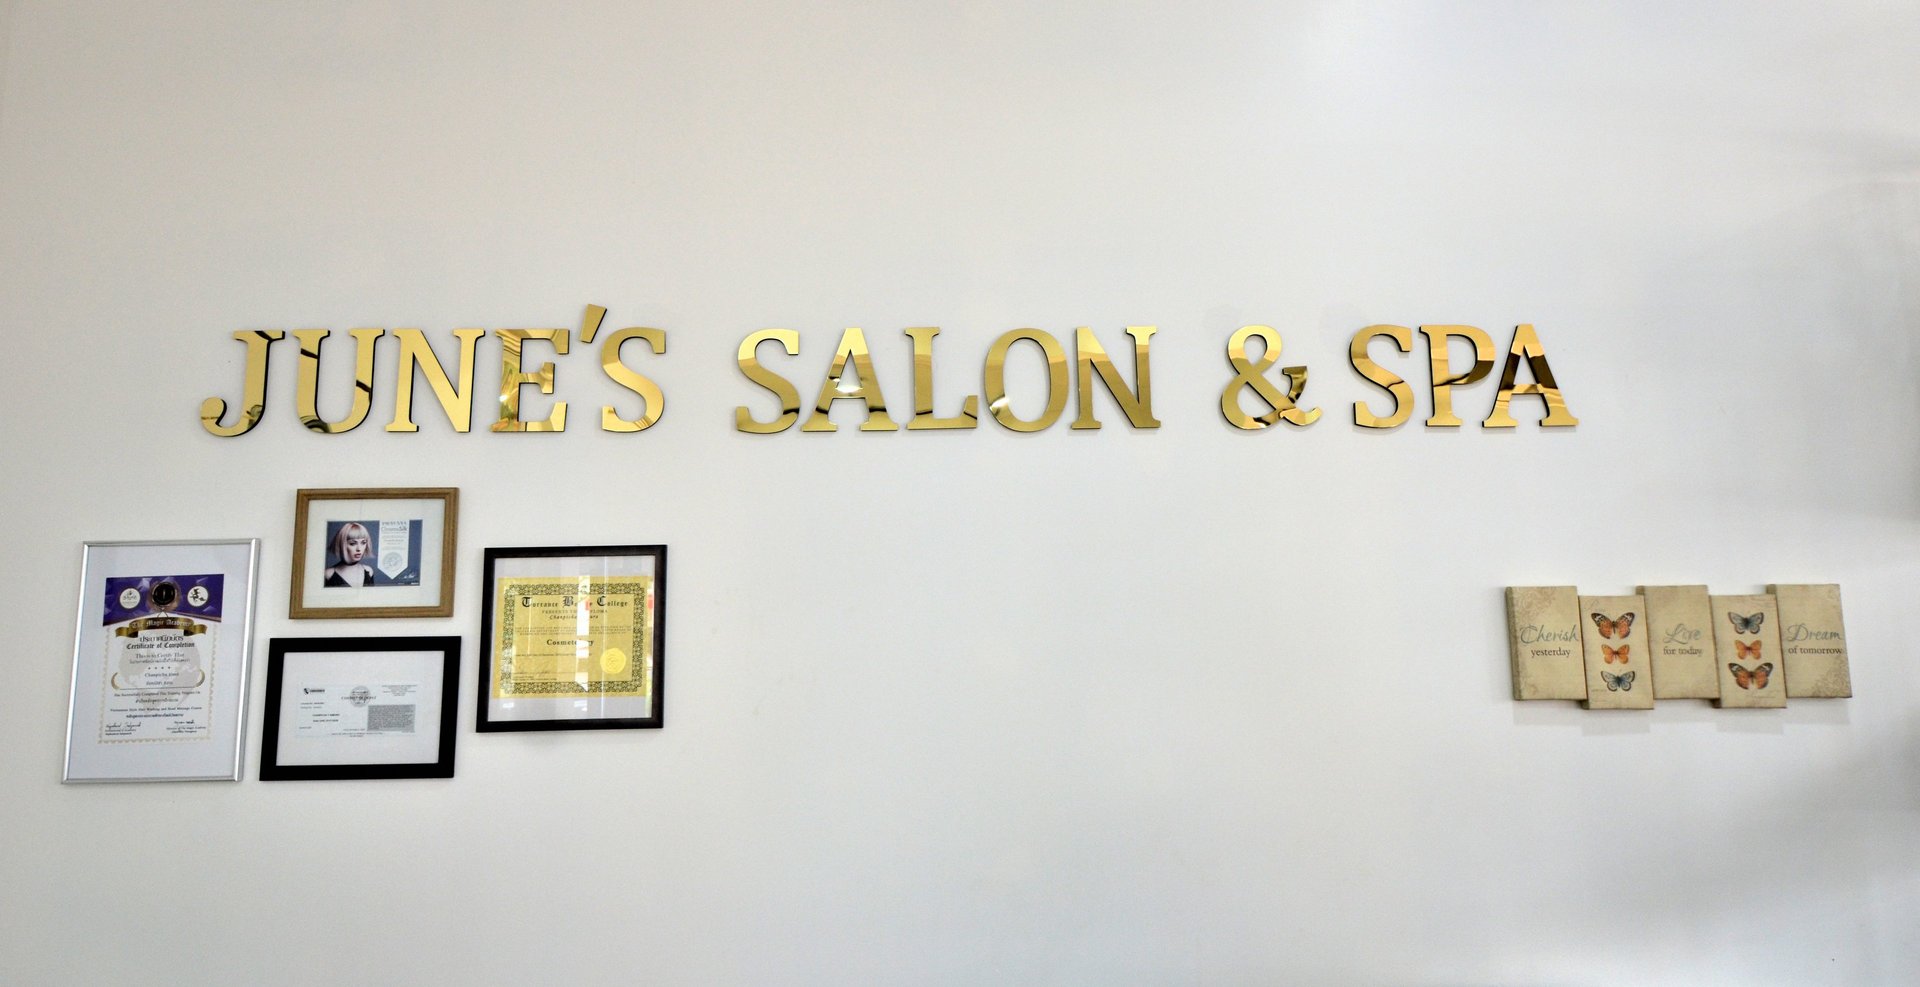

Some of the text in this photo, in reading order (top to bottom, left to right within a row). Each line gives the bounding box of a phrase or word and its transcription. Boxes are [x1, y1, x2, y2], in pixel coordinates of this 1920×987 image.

[200, 303, 1579, 437] JUNE'S SALON & SPA
[522, 597, 558, 608] Torrance
[597, 596, 628, 608] College
[1519, 623, 1579, 644] Cherish
[1662, 623, 1701, 645] Live
[1787, 623, 1843, 642] Dream
[126, 642, 155, 650] Certificate
[164, 641, 195, 650] Completion
[1663, 646, 1703, 657] for today
[1788, 645, 1842, 655] of tomorrow
[1531, 647, 1571, 658] yesterday
